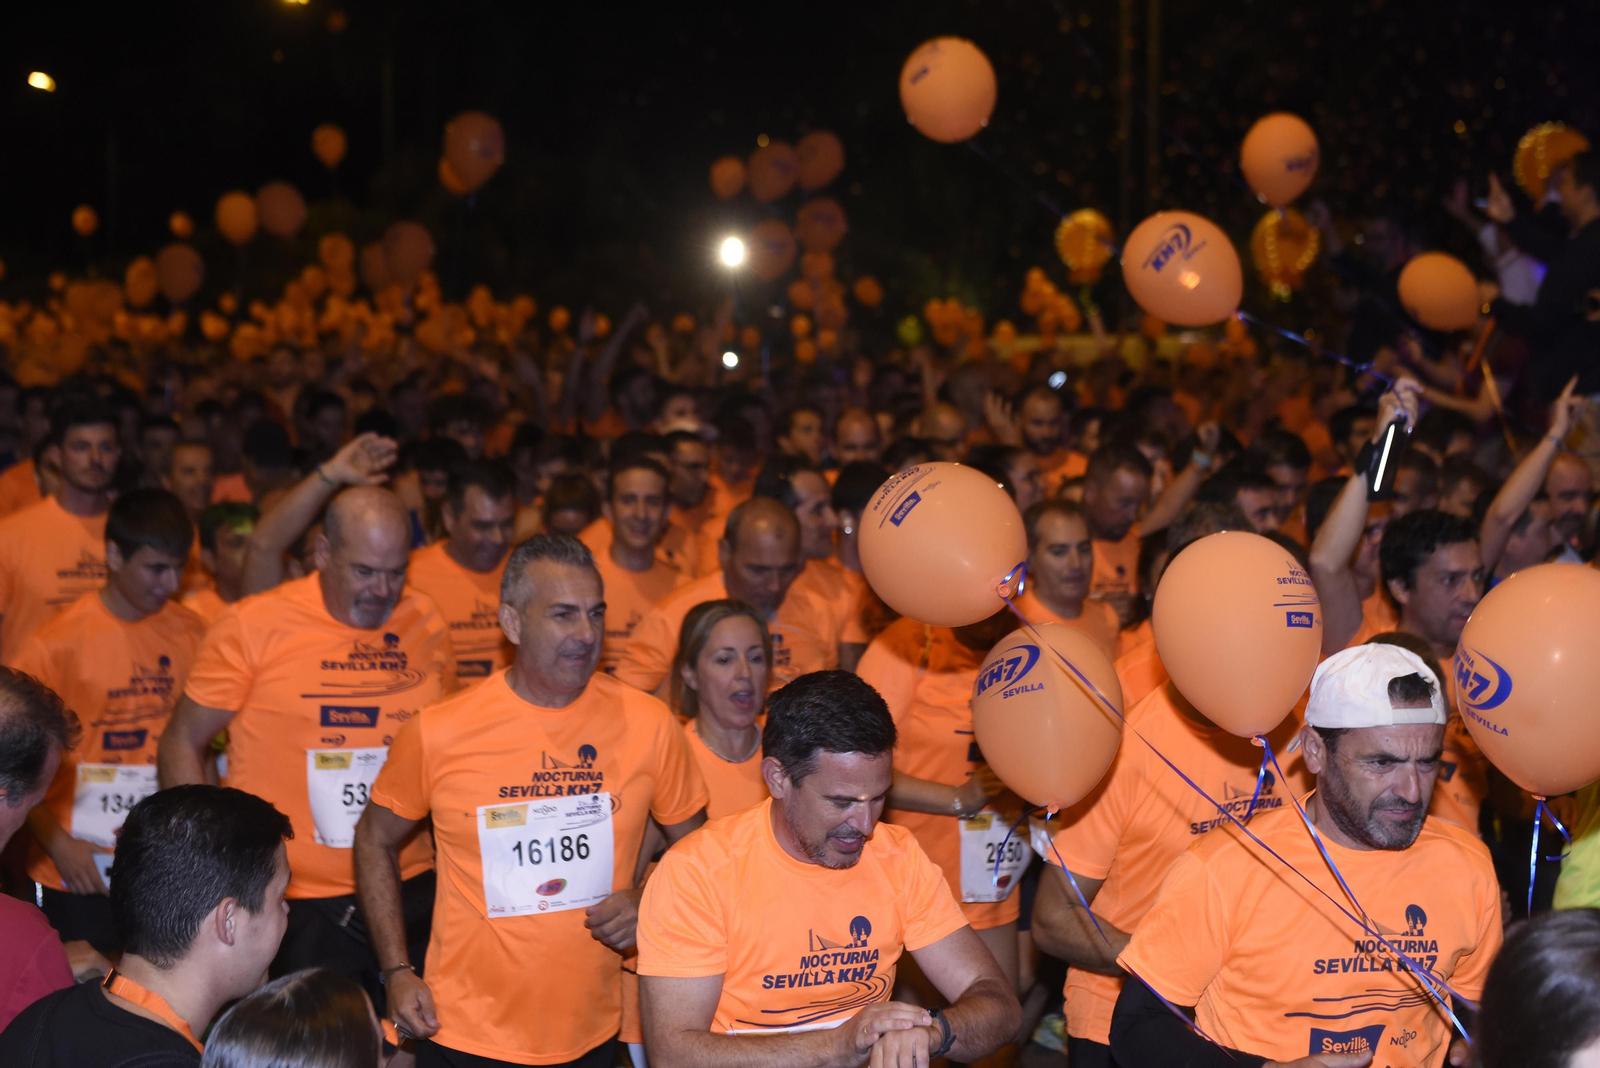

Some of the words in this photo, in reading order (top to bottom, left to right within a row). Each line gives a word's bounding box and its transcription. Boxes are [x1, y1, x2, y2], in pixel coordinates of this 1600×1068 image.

[320, 660, 377, 671] SEVILLA
[1002, 682, 1044, 699] SEVILLA
[1466, 706, 1509, 737] SEVILLA
[532, 771, 604, 783] NOCTURNA
[498, 784, 565, 799] SEVILLA
[1217, 797, 1282, 816] NOCTURNA
[512, 833, 590, 868] 16186
[1354, 939, 1438, 953] NOCTURNA
[800, 949, 879, 970] NOCTURNA
[1313, 956, 1393, 974] SEVILLA
[762, 970, 835, 990] SEVILLA
[1321, 1036, 1369, 1053] Sevilla
